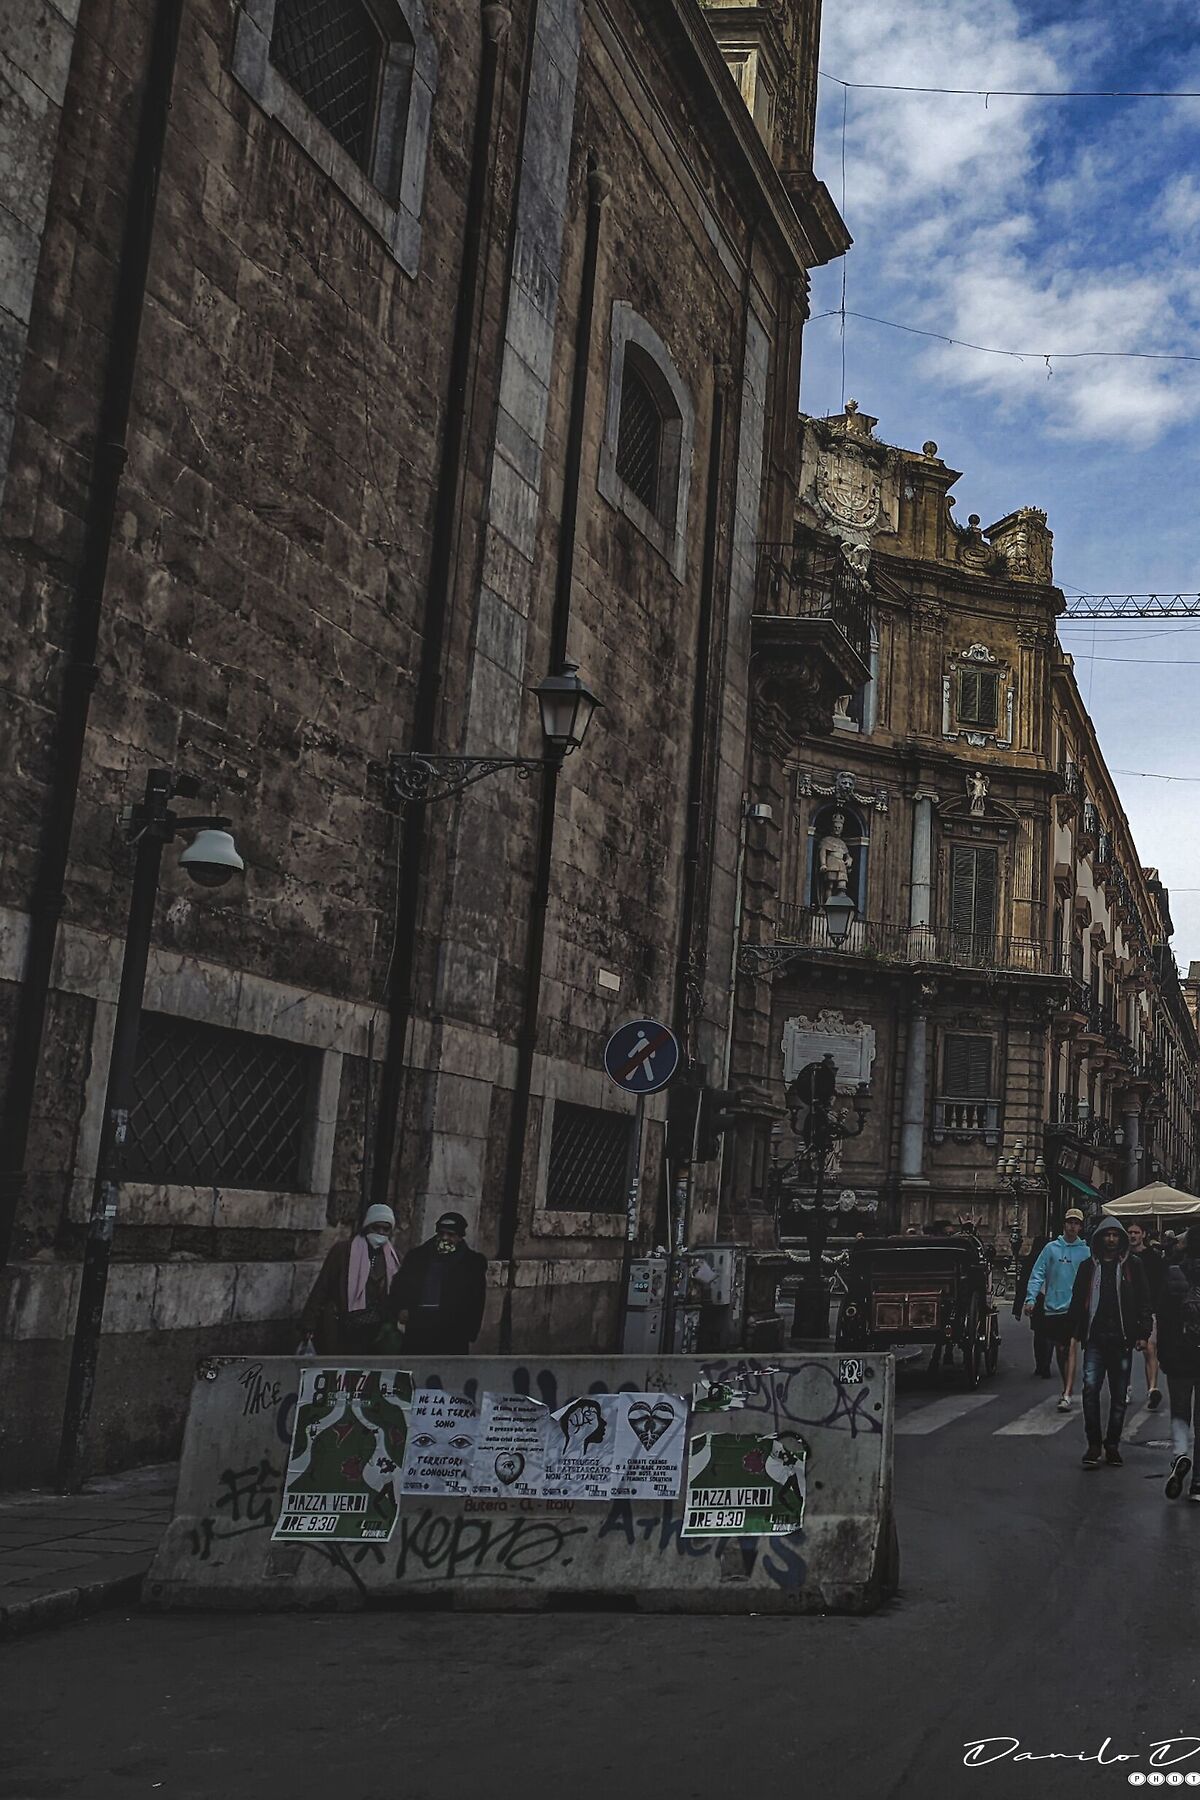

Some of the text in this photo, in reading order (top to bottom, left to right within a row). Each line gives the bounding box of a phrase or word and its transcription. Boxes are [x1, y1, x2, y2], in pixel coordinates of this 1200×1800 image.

[433, 1396, 445, 1405] LA
[431, 1407, 442, 1416] LA
[447, 1408, 476, 1418] TERRA
[434, 1419, 455, 1428] SONO
[417, 1455, 463, 1467] TERRITORI
[420, 1468, 467, 1478] CONQUISTA
[287, 1494, 366, 1511] PIAZZA VERDI
[691, 1490, 732, 1506] PIAZZA
[737, 1489, 771, 1505] VERDI
[546, 1499, 575, 1512] Italy
[280, 1516, 337, 1531] ORE 9:30
[688, 1511, 743, 1527] ORE 9:30
